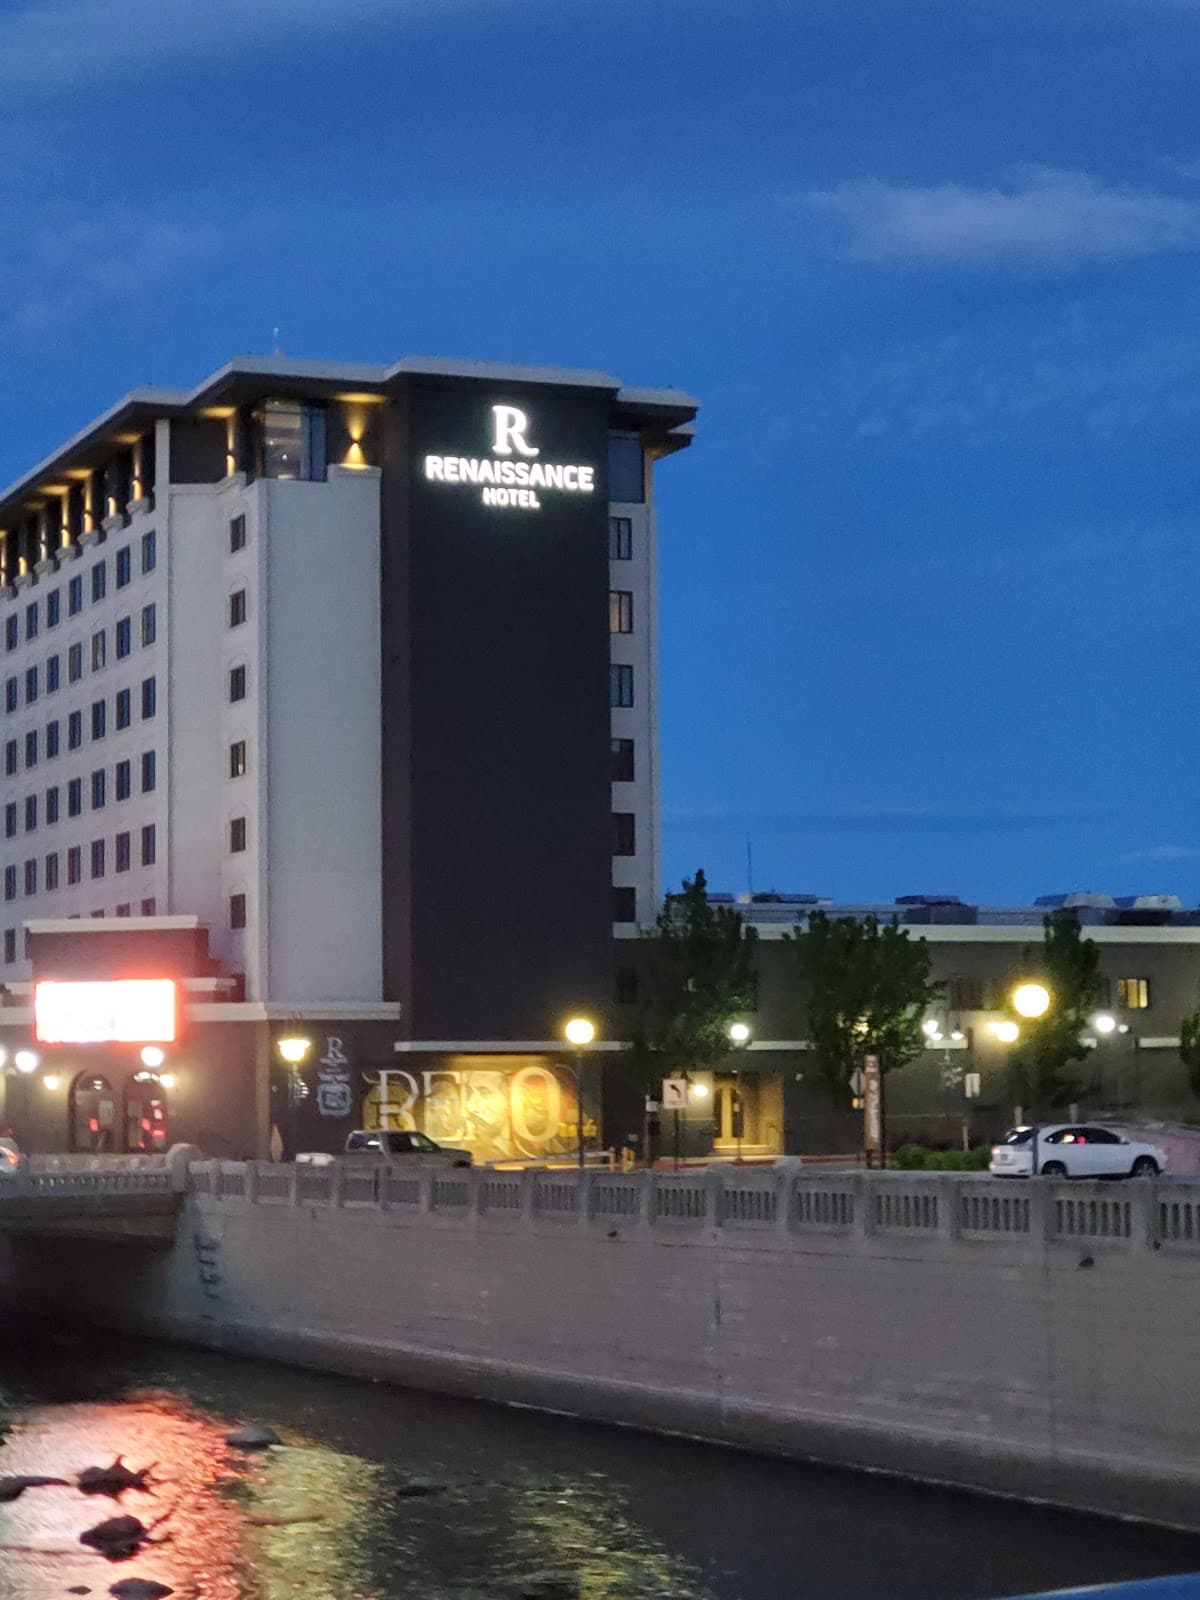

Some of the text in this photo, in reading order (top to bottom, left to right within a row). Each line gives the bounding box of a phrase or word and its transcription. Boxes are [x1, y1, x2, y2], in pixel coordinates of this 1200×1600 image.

[492, 405, 539, 456] R
[425, 455, 594, 491] RENAISSANCE
[482, 487, 540, 508] HOTEL
